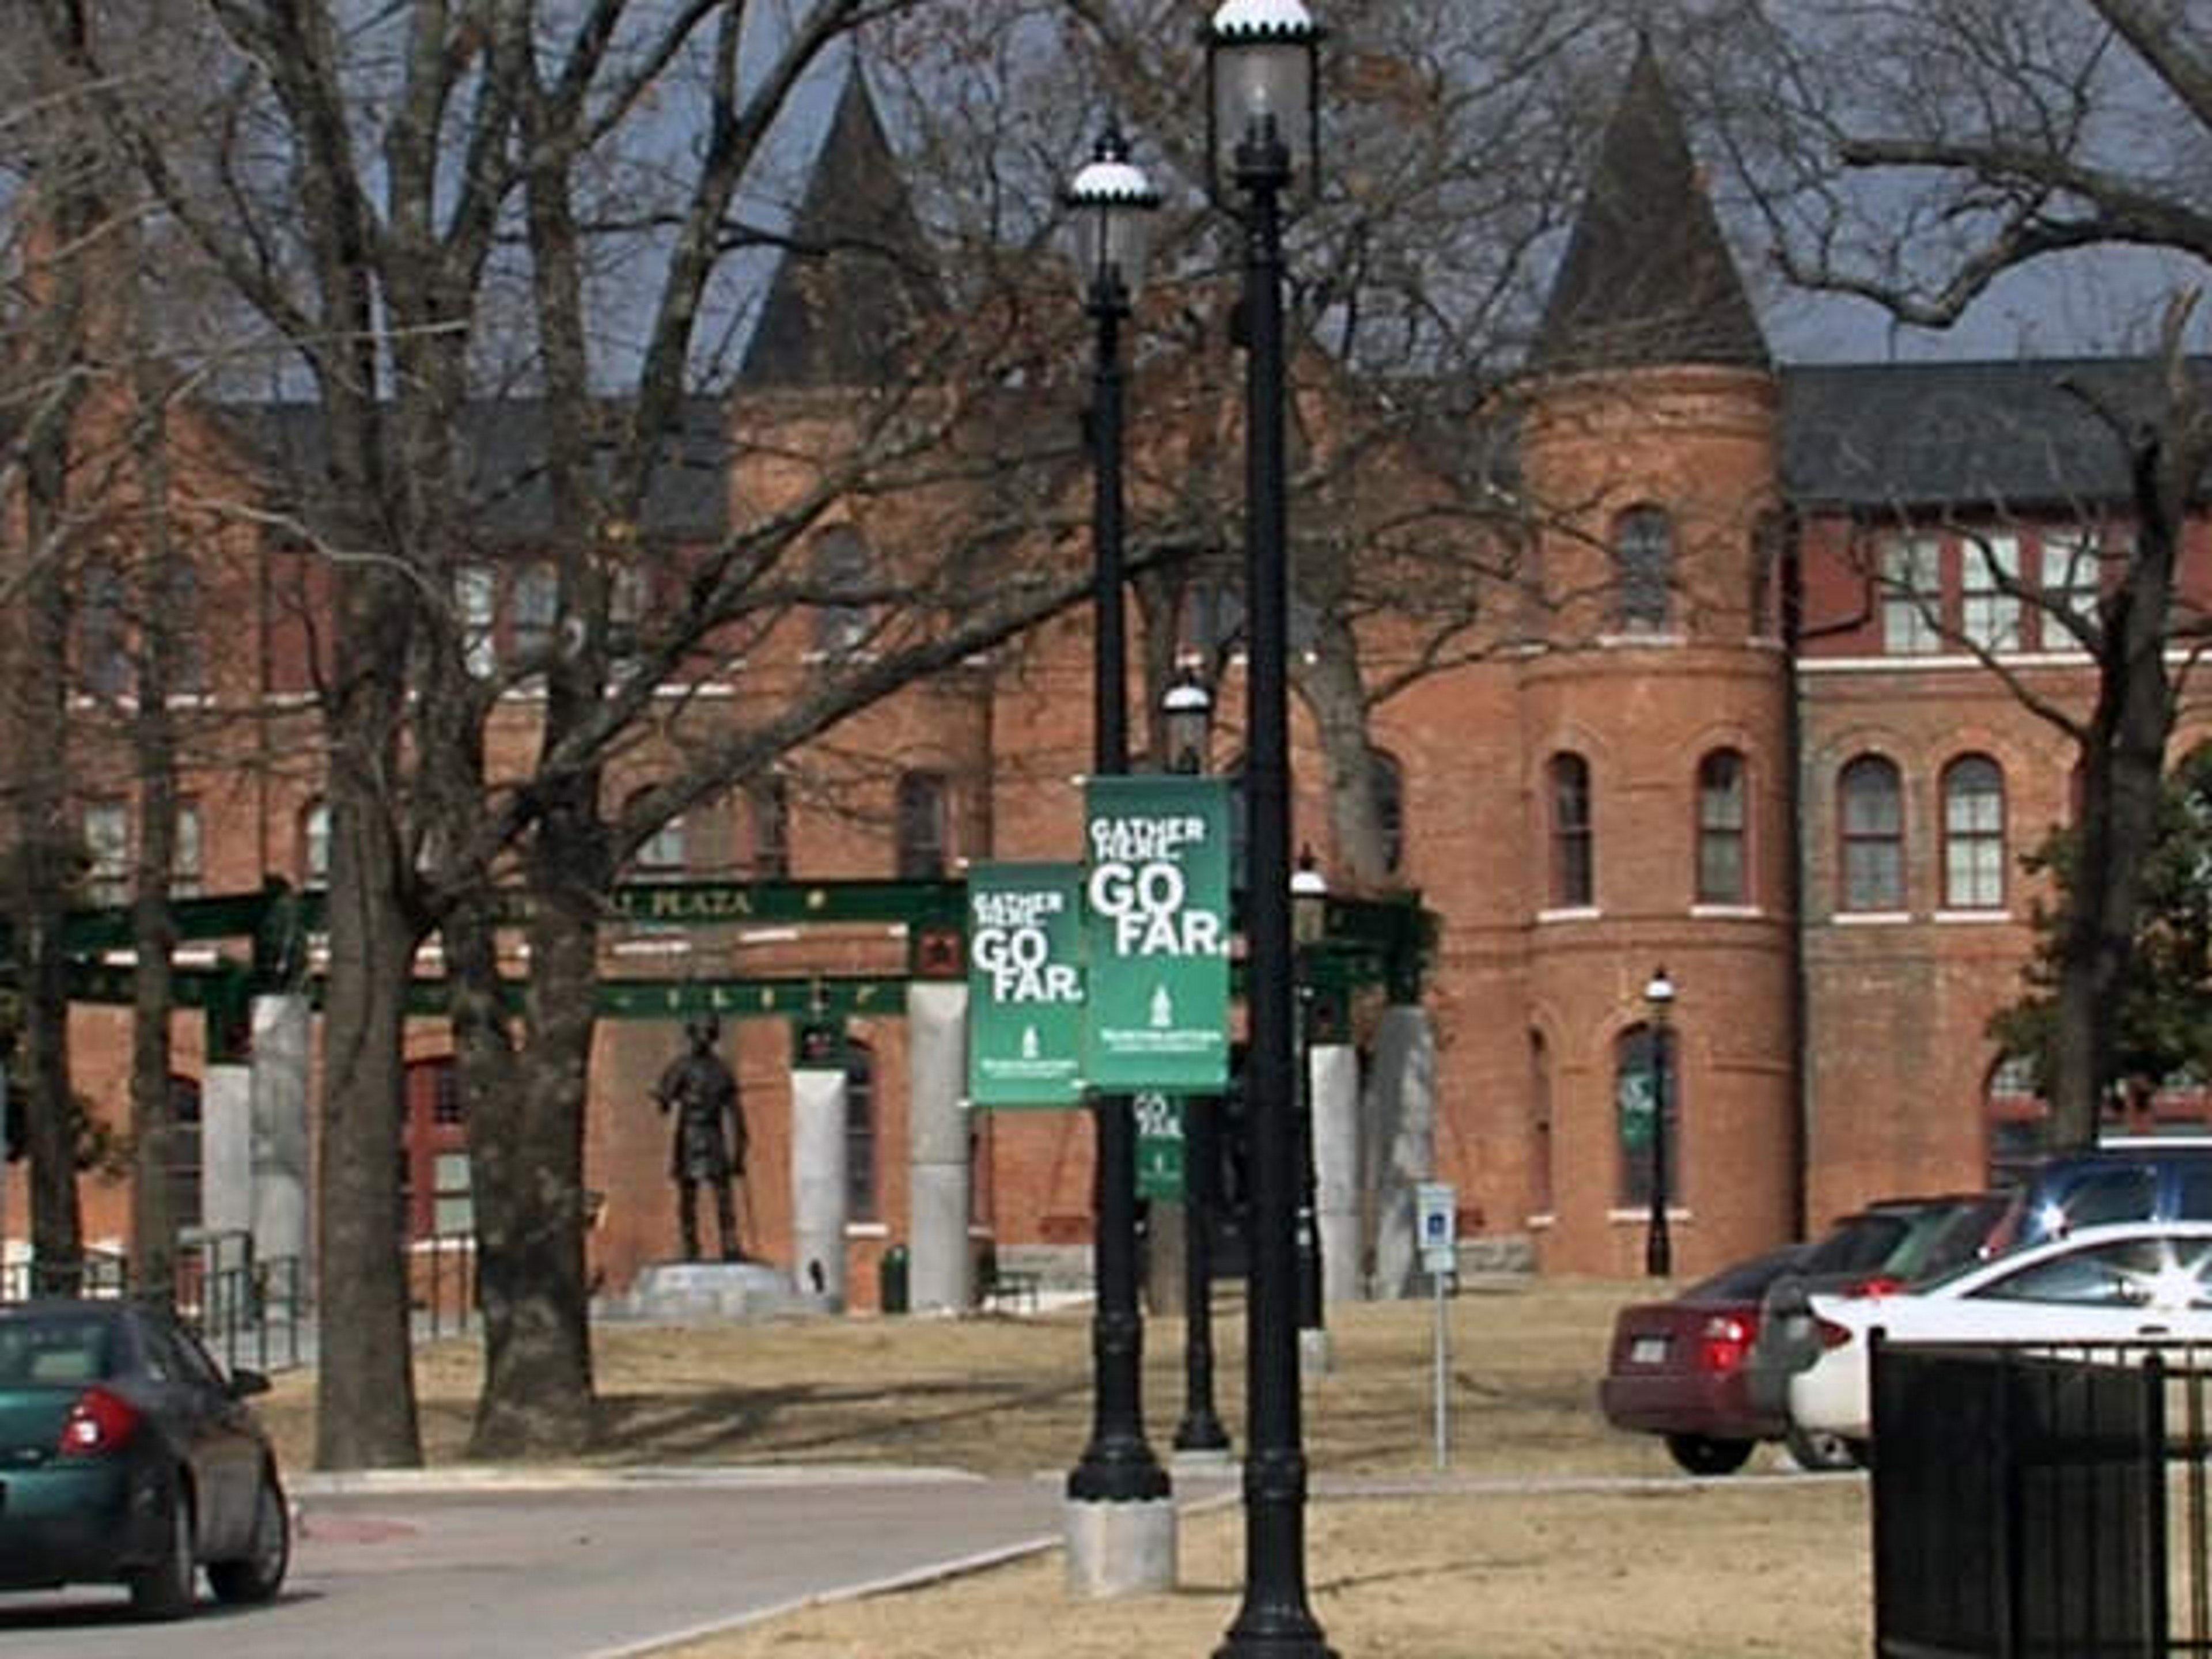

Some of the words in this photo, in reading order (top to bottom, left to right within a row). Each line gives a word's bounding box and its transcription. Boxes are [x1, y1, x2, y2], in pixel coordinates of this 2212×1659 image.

[1091, 817, 1204, 842] GATHER
[972, 892, 1063, 913] GATHER
[1089, 863, 1184, 916] GO
[971, 929, 1048, 971] GO
[1116, 909, 1230, 956] FAR.
[995, 964, 1083, 1002] FAR.
